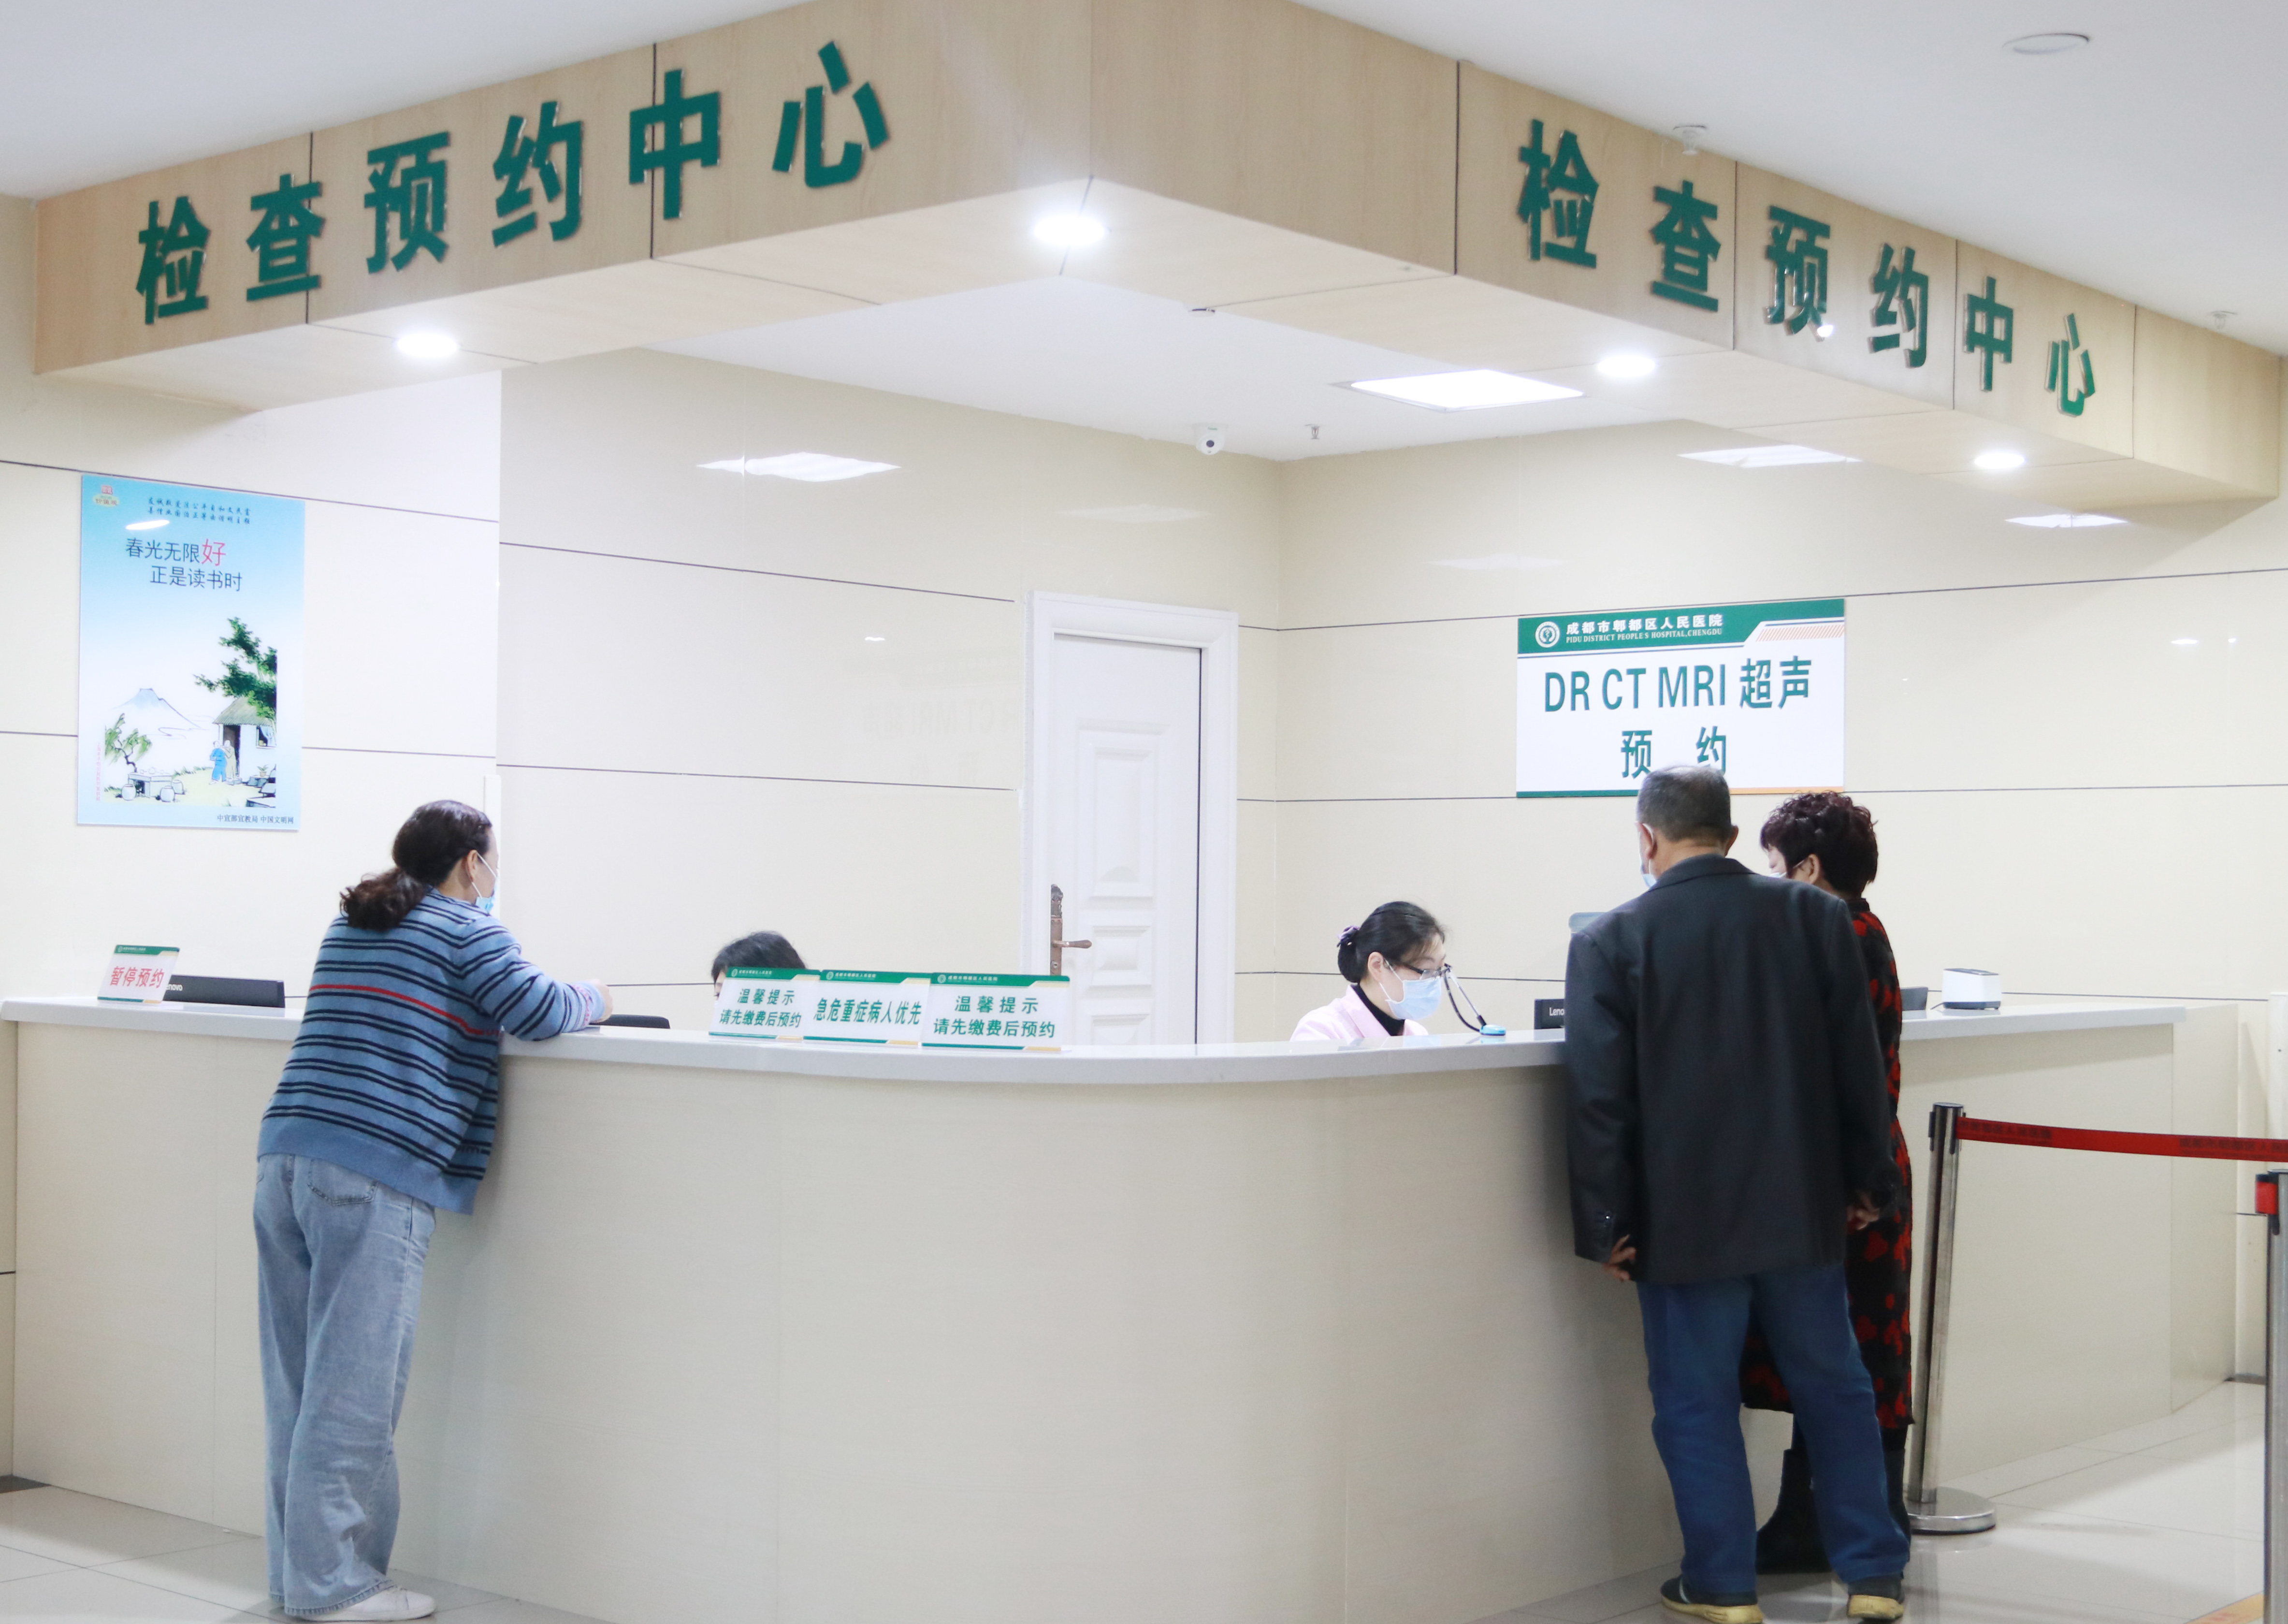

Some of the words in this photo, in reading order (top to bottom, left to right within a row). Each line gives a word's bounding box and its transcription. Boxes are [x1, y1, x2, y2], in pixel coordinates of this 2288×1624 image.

[136, 42, 890, 325] 检查预约中心
[1518, 119, 2096, 417] 检查预约中心
[126, 537, 226, 566] 春光无限好
[150, 566, 243, 592] 正是读书时
[1566, 613, 1723, 635] 成都市郫都区人民医院
[1583, 634, 1615, 642] DISTRICT
[1618, 632, 1649, 640] PEOPLES
[1545, 671, 1590, 712] DR
[1602, 667, 1646, 710] CT
[1658, 664, 1725, 708] MRI
[1739, 655, 1811, 709] 超声
[110, 966, 164, 988] 暂停预约
[737, 988, 796, 1006] 温馨提示
[953, 995, 1039, 1015] 温馨提示
[719, 1008, 802, 1029] 请先缴费后预约
[813, 997, 923, 1026] 急危重症病人优先
[933, 1017, 1056, 1039] 请先缴费后预约
